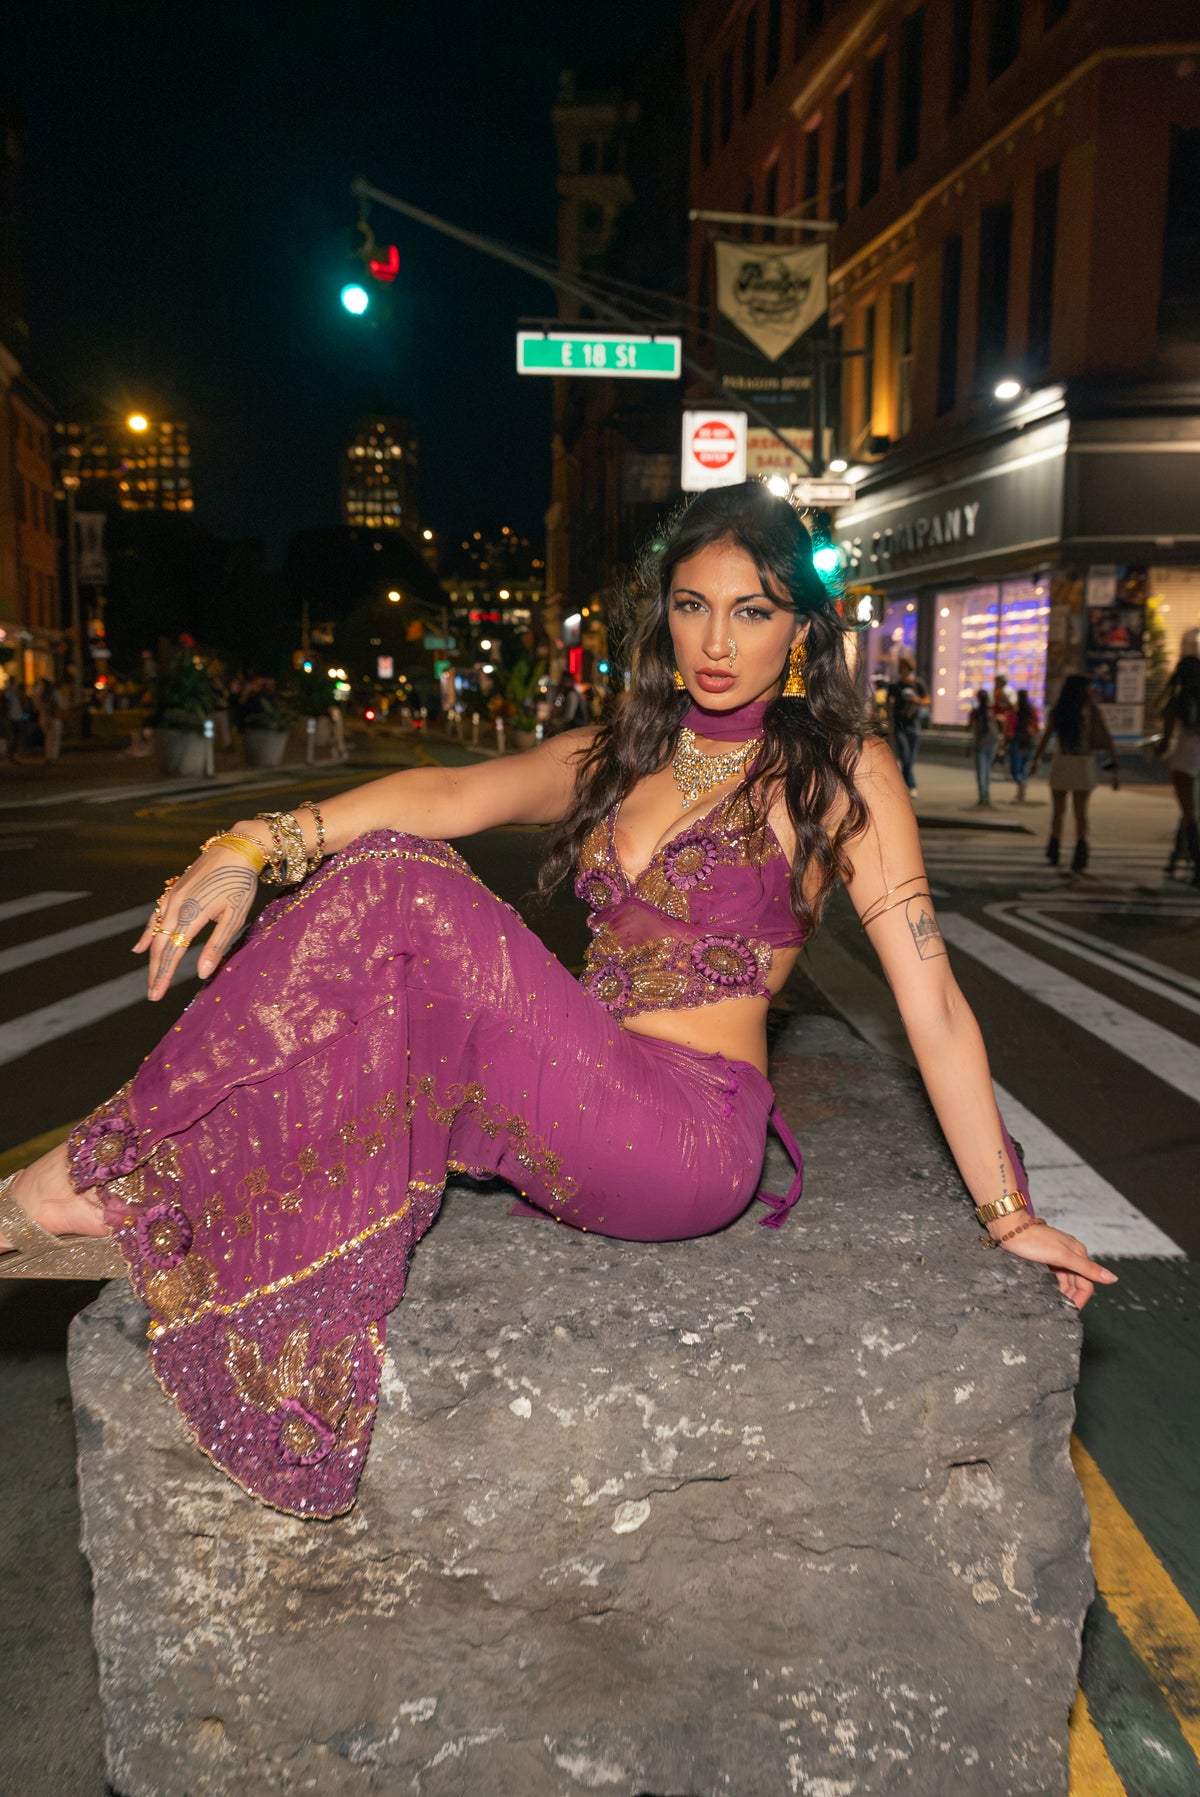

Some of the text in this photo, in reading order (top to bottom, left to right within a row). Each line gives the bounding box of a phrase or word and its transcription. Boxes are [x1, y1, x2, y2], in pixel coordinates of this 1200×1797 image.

[561, 342, 573, 367] E
[615, 344, 637, 369] St
[713, 427, 730, 438] NOT
[757, 455, 794, 468] SALE
[870, 501, 979, 563] COMPANY
